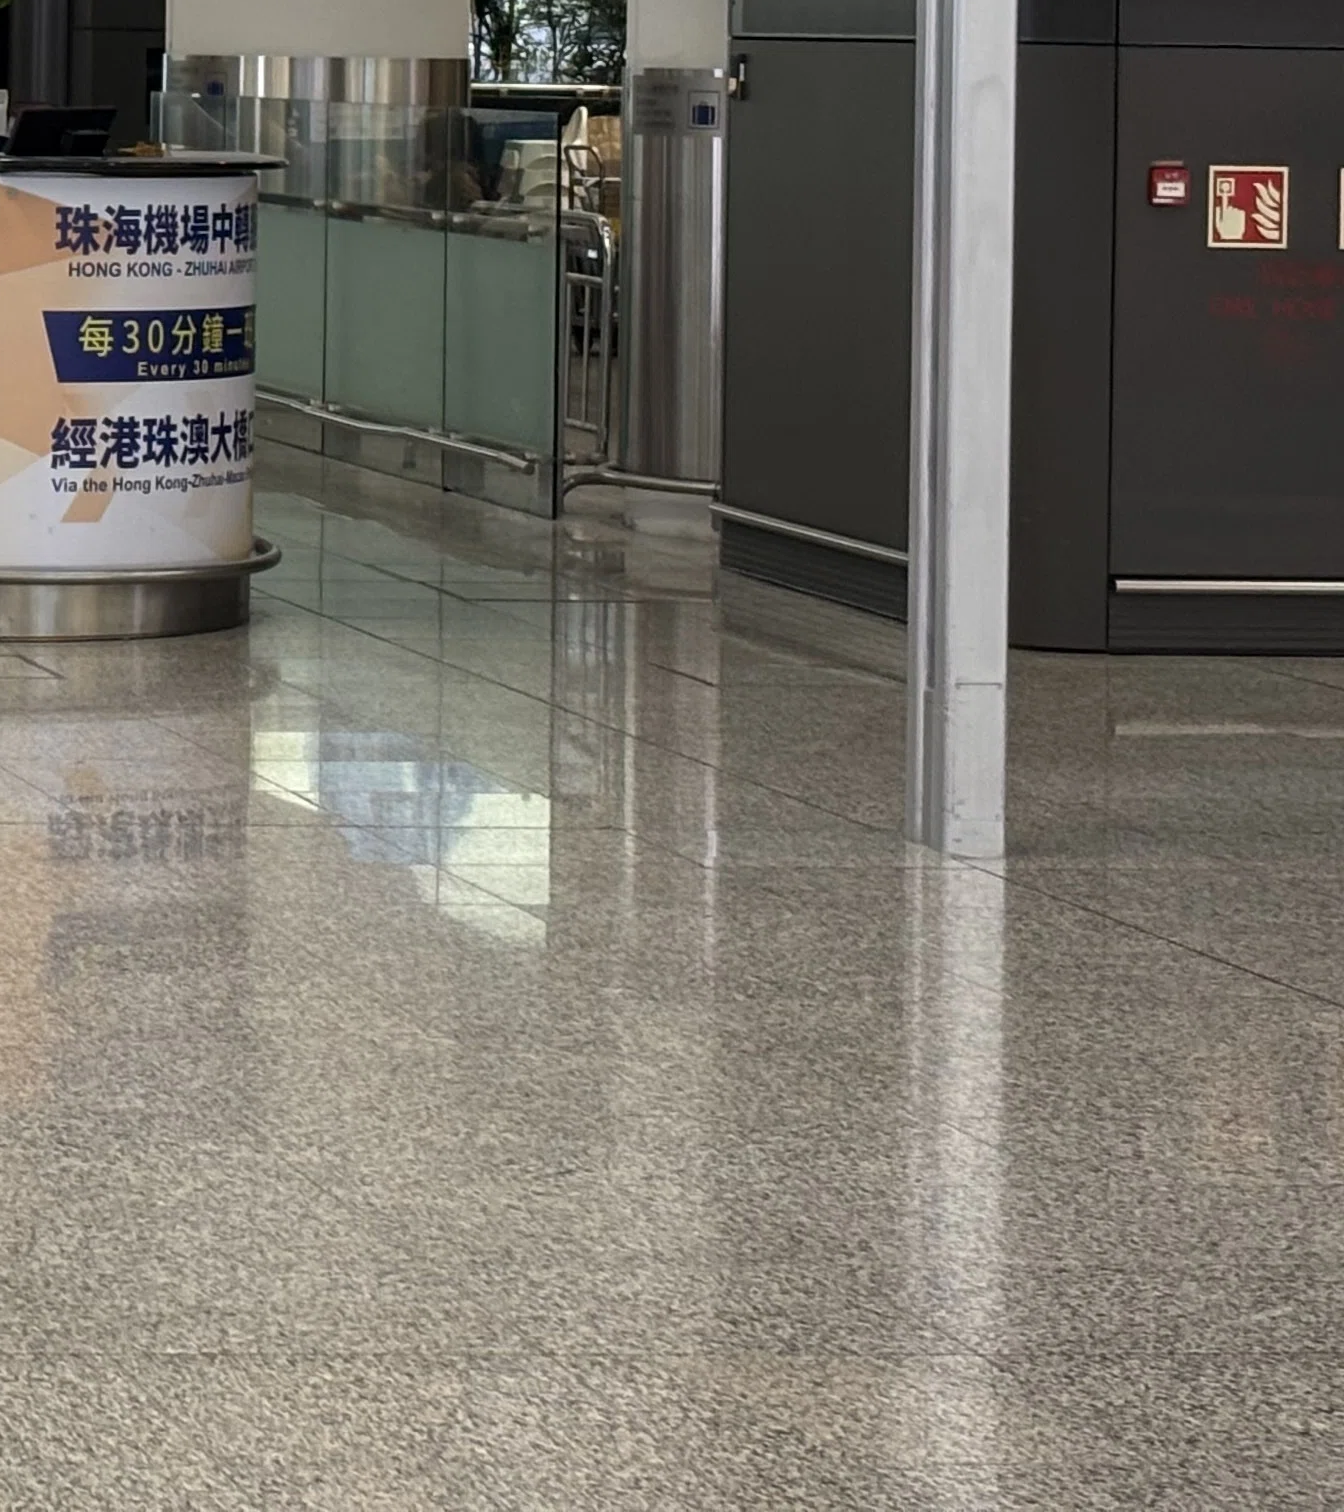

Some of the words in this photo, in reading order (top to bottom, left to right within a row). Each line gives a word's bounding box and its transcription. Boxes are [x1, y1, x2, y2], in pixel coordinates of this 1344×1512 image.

[55, 202, 257, 255] 珠海機場中轉
[68, 261, 122, 278] HONG
[126, 261, 173, 278] KONG
[184, 260, 227, 277] ZHUHAI
[137, 361, 187, 378] Every
[193, 359, 209, 375] 30
[51, 478, 77, 493] Via
[83, 478, 108, 493] the
[113, 477, 150, 495] Hong
